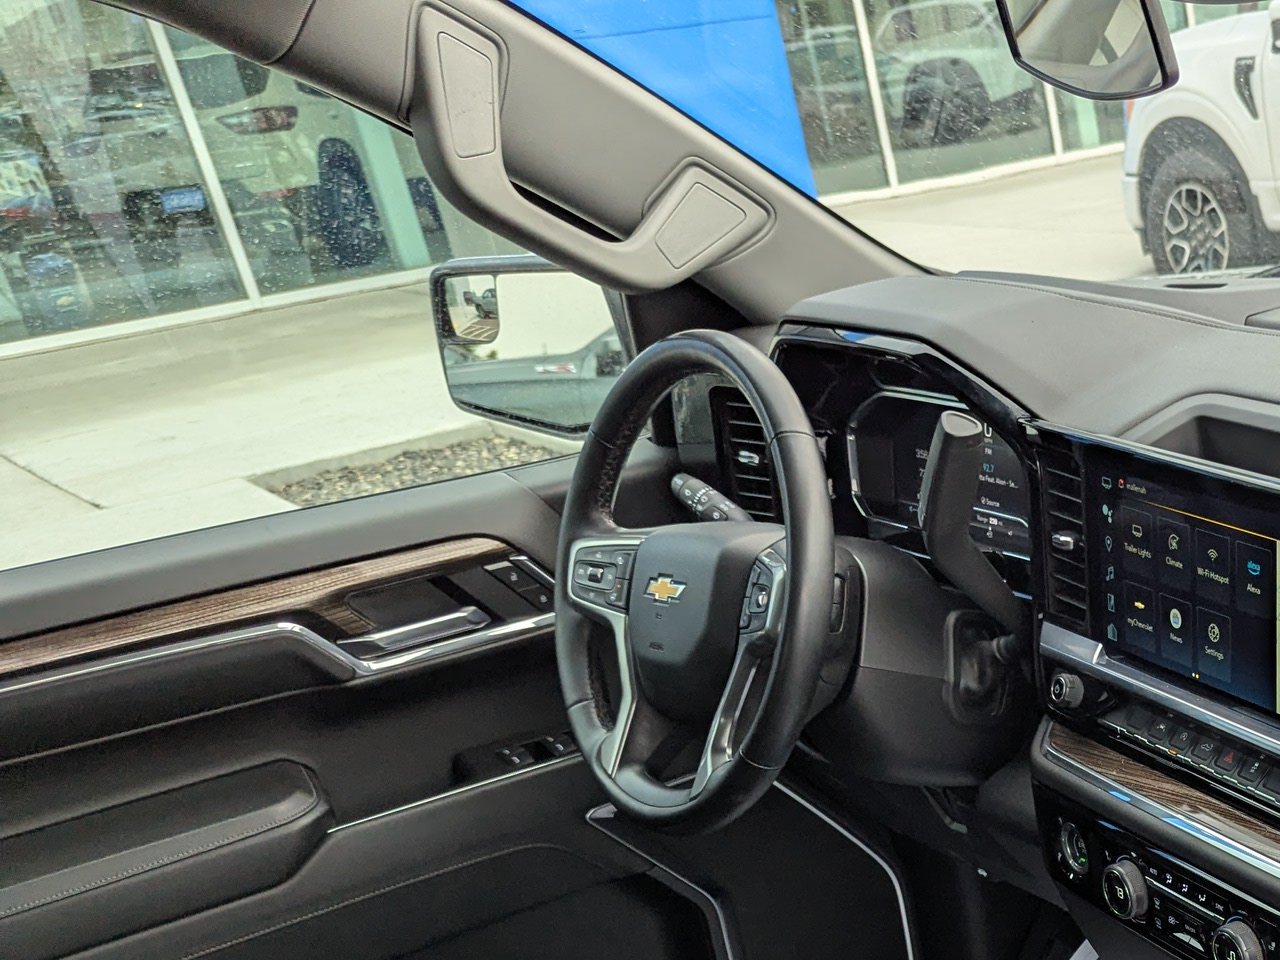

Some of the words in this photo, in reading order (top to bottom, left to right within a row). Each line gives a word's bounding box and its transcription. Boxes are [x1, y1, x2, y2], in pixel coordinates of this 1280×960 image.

[1137, 546, 1152, 559] Lights
[1165, 556, 1185, 570] Climate
[1209, 570, 1230, 585] Hotspot
[1247, 583, 1261, 595] Alexa
[1169, 632, 1183, 644] News
[1204, 645, 1225, 661] Settings
